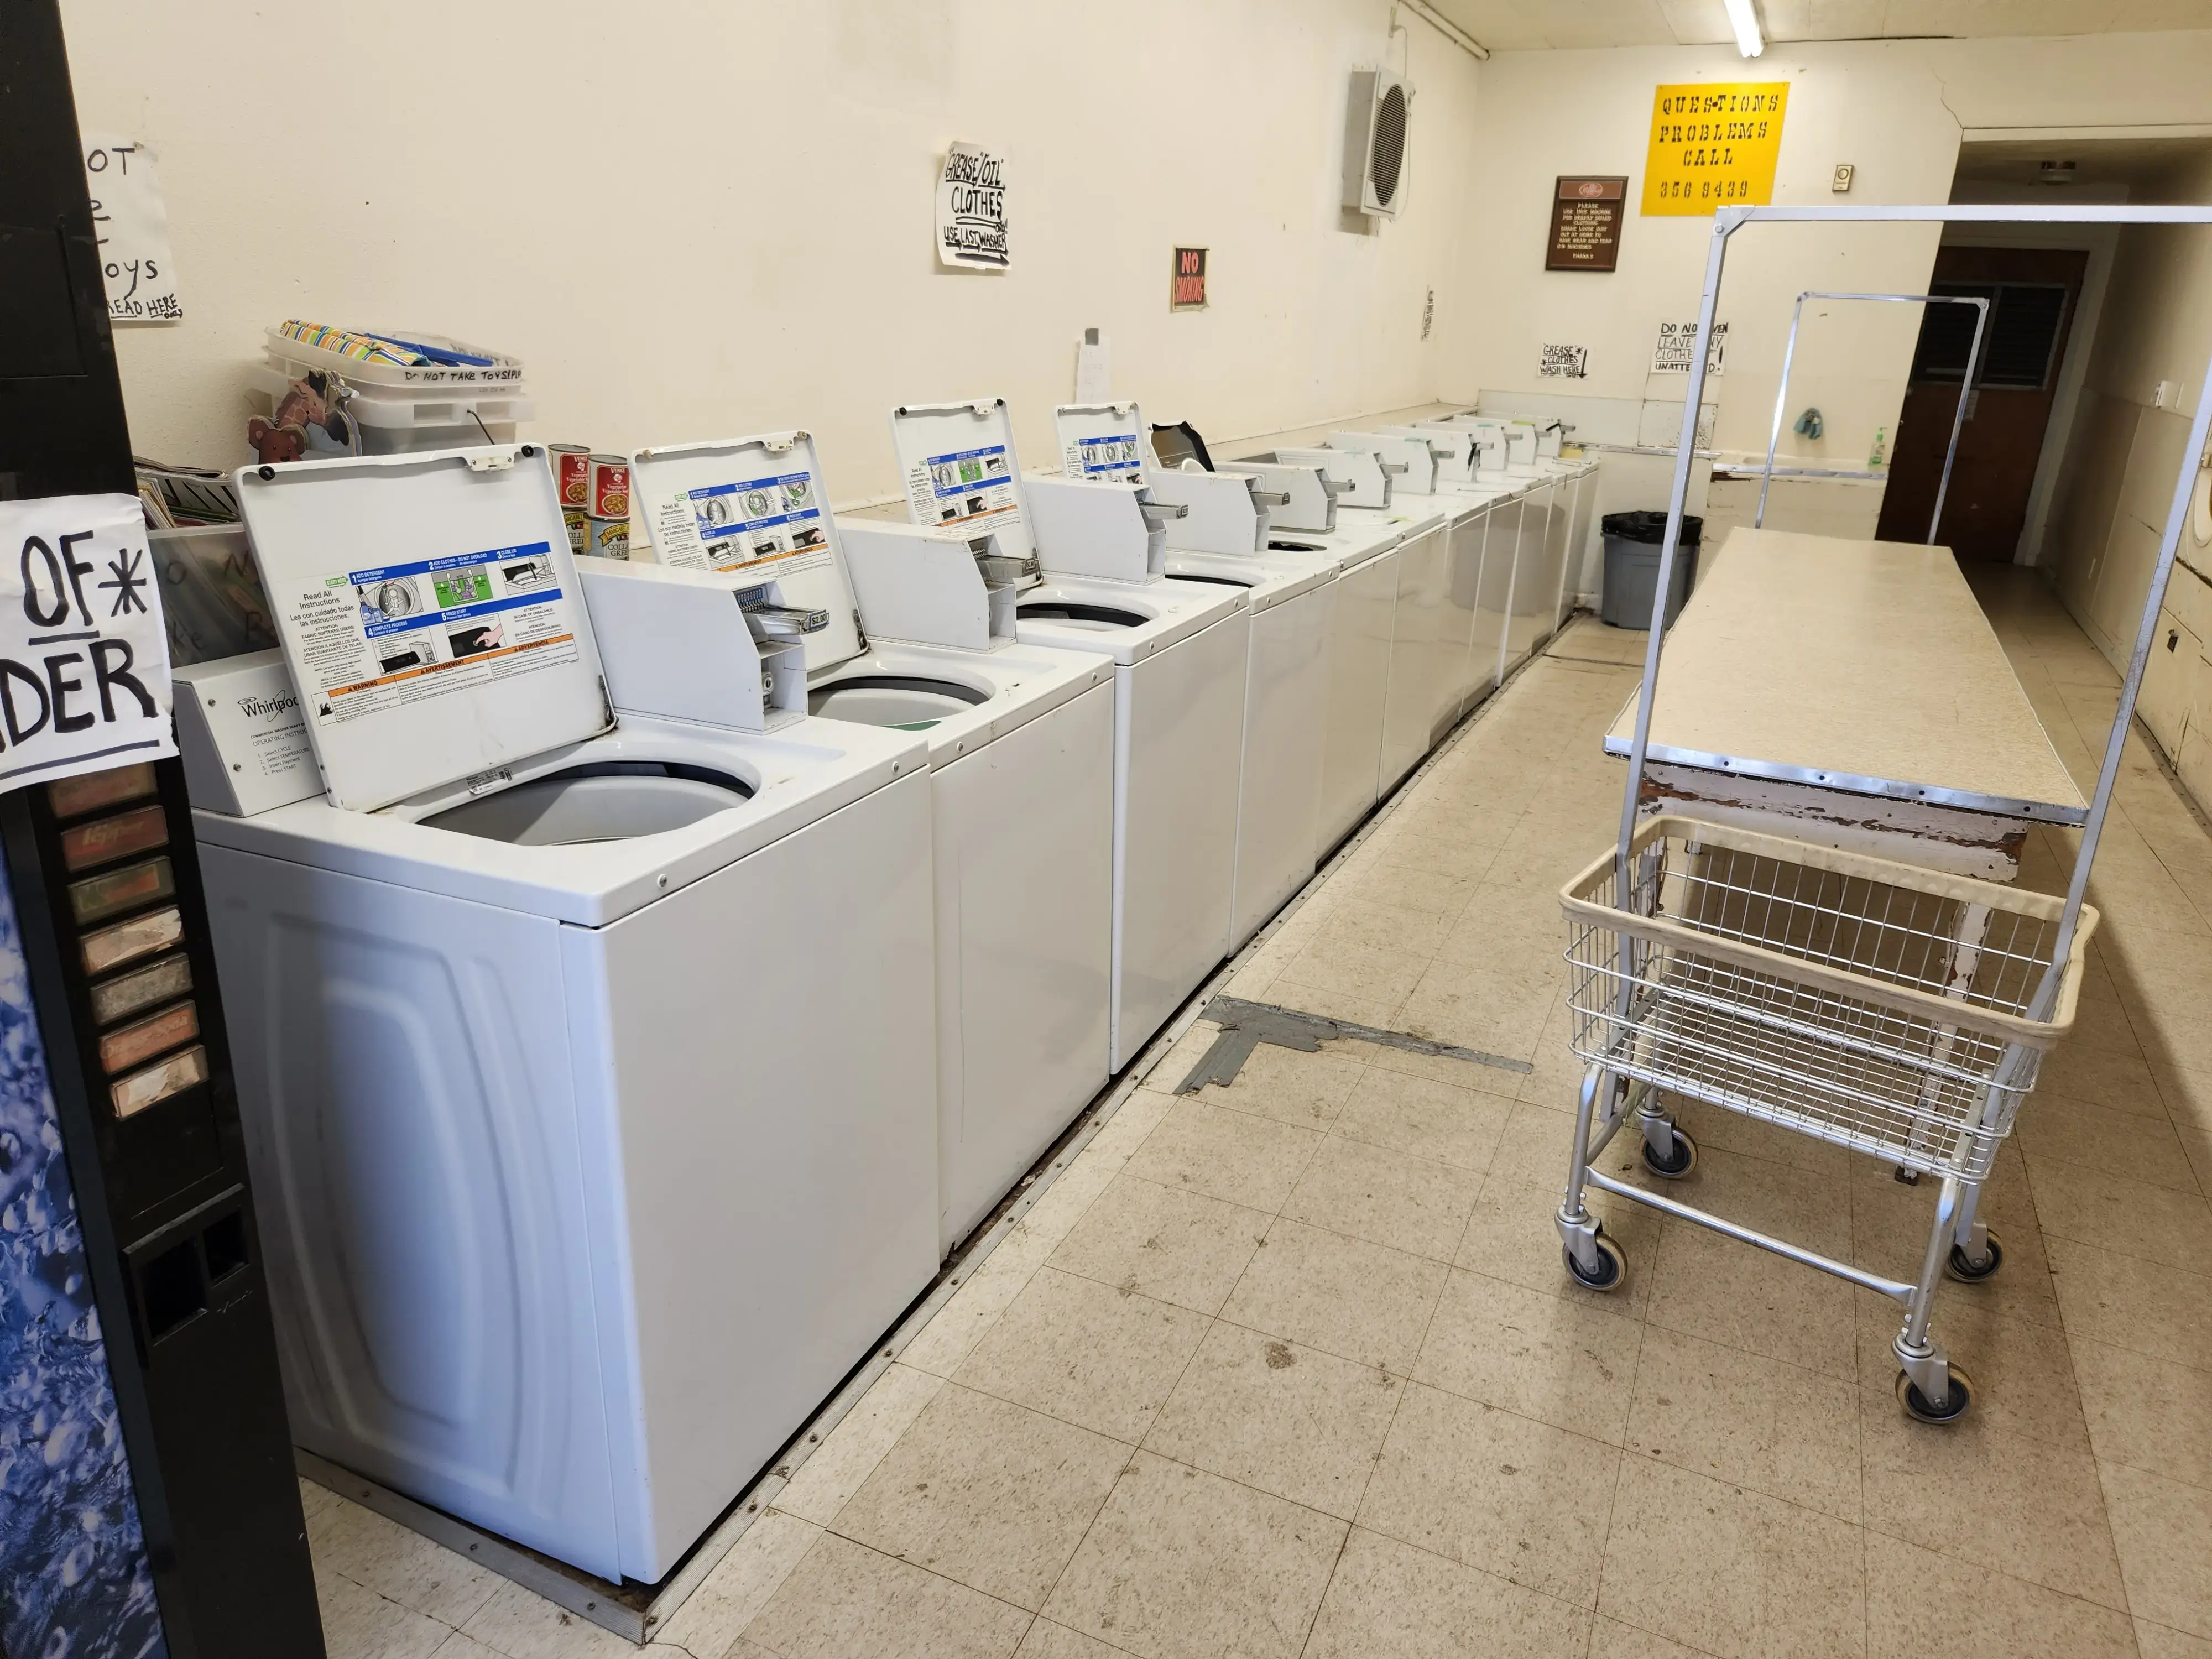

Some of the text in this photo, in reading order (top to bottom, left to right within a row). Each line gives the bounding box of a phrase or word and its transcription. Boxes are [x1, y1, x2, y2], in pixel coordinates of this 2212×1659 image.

[1662, 95, 1778, 115] QUESTIONS
[1658, 121, 1767, 143] PROBLEMS
[87, 148, 135, 175] OT
[1683, 148, 1733, 166] CALL
[1660, 180, 1747, 199] 356 9439
[951, 186, 1003, 220] CLOTHES
[943, 225, 1006, 251] USE LAST WASHER
[1181, 252, 1199, 274] NO
[105, 259, 158, 300] oys
[1175, 276, 1204, 303] SMOKING
[146, 293, 178, 315] HERE
[1661, 322, 1729, 334] DO NO VEN
[1657, 336, 1694, 349] LEAVE
[1543, 345, 1574, 356] GREASE
[1655, 349, 1693, 360] CLOTHE
[1547, 356, 1578, 364] CLOTHES
[1540, 366, 1580, 374] WASH HERE
[424, 372, 446, 382] NOT
[429, 561, 434, 570] 2
[20, 530, 94, 627] OF
[352, 574, 357, 583] 1
[364, 569, 385, 577] DETERGENT
[303, 592, 322, 601] Read
[299, 597, 340, 609] Instructions
[290, 613, 301, 622] Lea
[315, 607, 337, 617] cuidado
[339, 604, 354, 613] todas
[310, 613, 349, 625] instrucciones.
[441, 613, 447, 621] 5
[811, 614, 826, 625] $2.00
[317, 628, 340, 637] SOFTENER
[368, 628, 373, 637] 4
[372, 623, 392, 632] COMPLETE
[316, 646, 342, 655] SUAVIZANTE
[518, 640, 550, 650] ADVERTENCIA
[425, 660, 465, 674] AVERTISSEMENT
[353, 680, 378, 690] WARNING
[0, 638, 159, 753] DER
[251, 730, 274, 739] COMMERCIAL
[253, 728, 308, 747] OPERATING INSTRUC
[280, 747, 310, 759] TEMPERATURE
[282, 757, 301, 765] Payment
